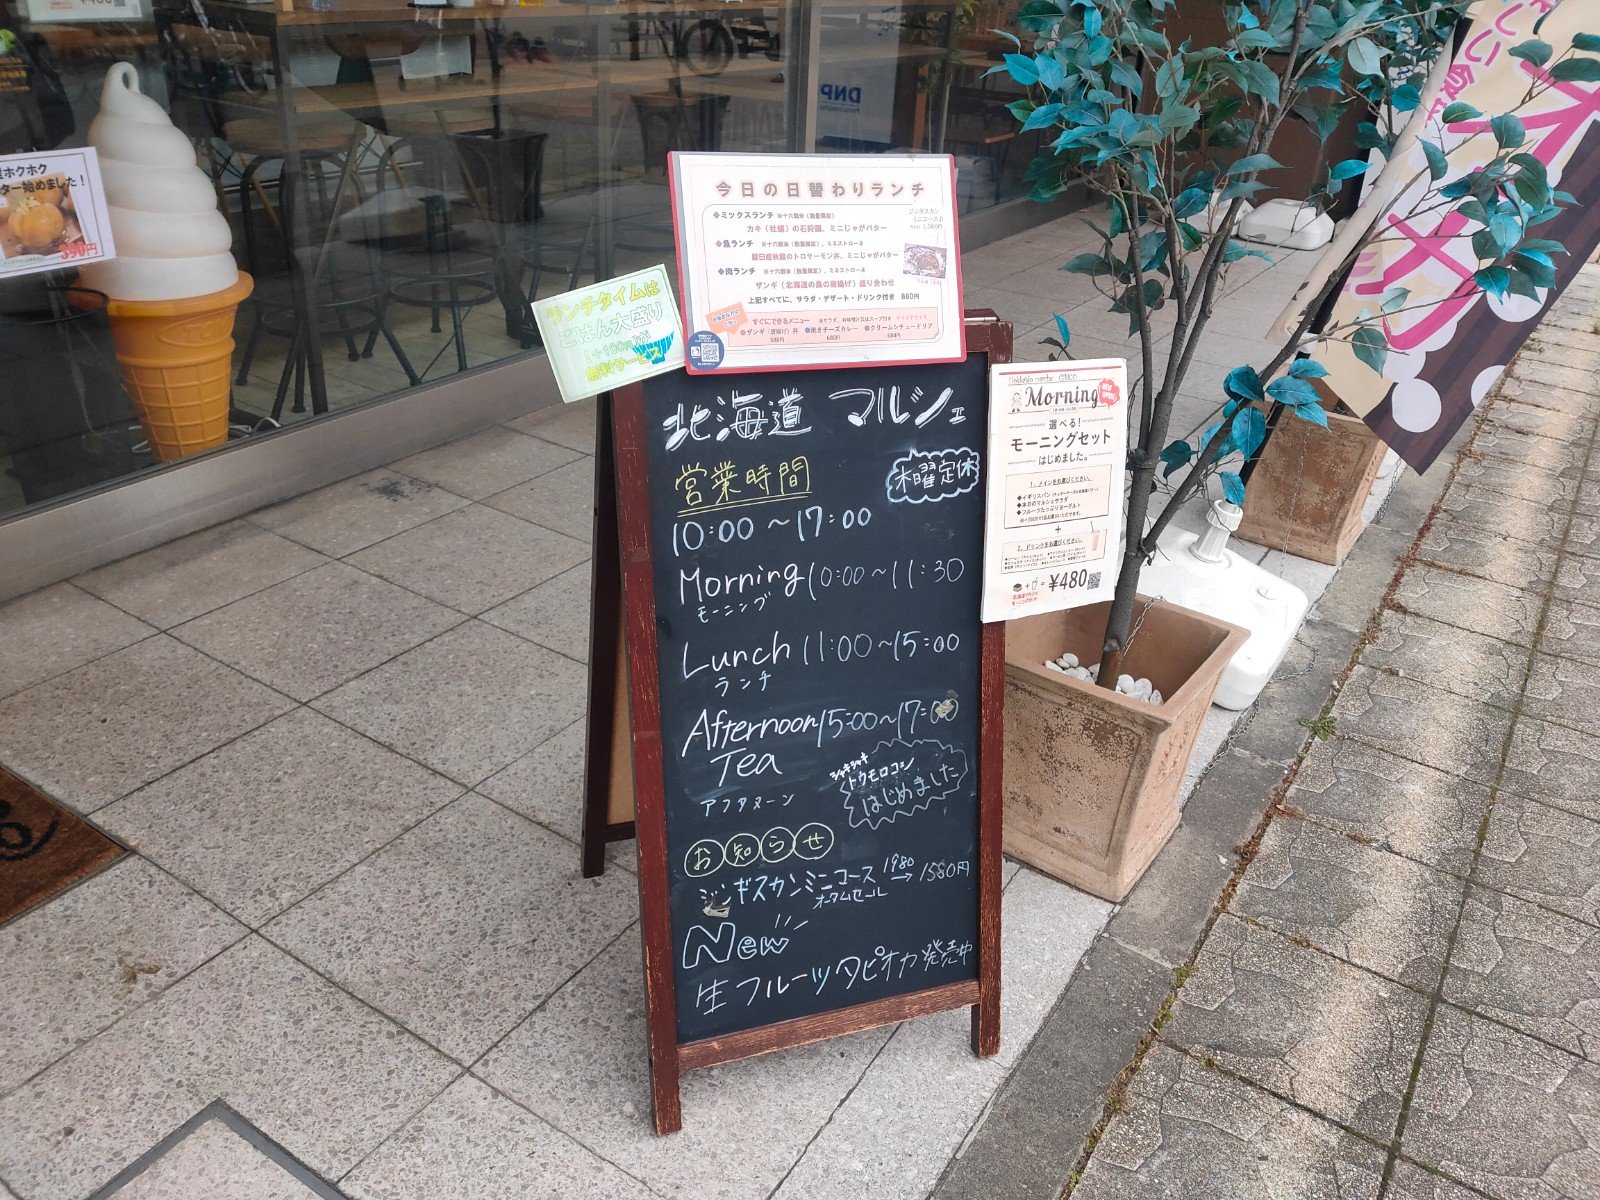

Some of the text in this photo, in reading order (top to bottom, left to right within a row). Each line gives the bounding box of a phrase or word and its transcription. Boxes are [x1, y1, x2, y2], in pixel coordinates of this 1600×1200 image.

[0, 163, 47, 180] ホクホク
[0, 174, 85, 196] ター始めました！
[715, 181, 924, 198] 今日の日替わりランチ
[721, 211, 774, 220] ミックスランチ
[722, 239, 754, 248] 魚ランチ
[725, 267, 756, 276] 肉ランチ
[546, 279, 661, 326] ランチタイムは
[558, 301, 663, 349] ごはん大盛り
[1025, 385, 1099, 409] Morning
[662, 387, 812, 452] 北海道
[1011, 429, 1111, 452] モーニングセット
[1038, 451, 1088, 466] はじめました。
[674, 456, 811, 507] 営業時間
[894, 459, 979, 493] 木曜定休
[680, 563, 805, 605] Morning
[1048, 569, 1088, 593] ¥480
[697, 592, 772, 624] モーニング
[681, 630, 790, 679] Lunch
[714, 669, 771, 698] ランチ
[681, 709, 819, 758] Afternoon
[710, 748, 783, 788] Tea
[862, 763, 960, 817] はじめました
[692, 832, 826, 872] お知らせ
[882, 853, 915, 875] 1980
[682, 922, 790, 971] New
